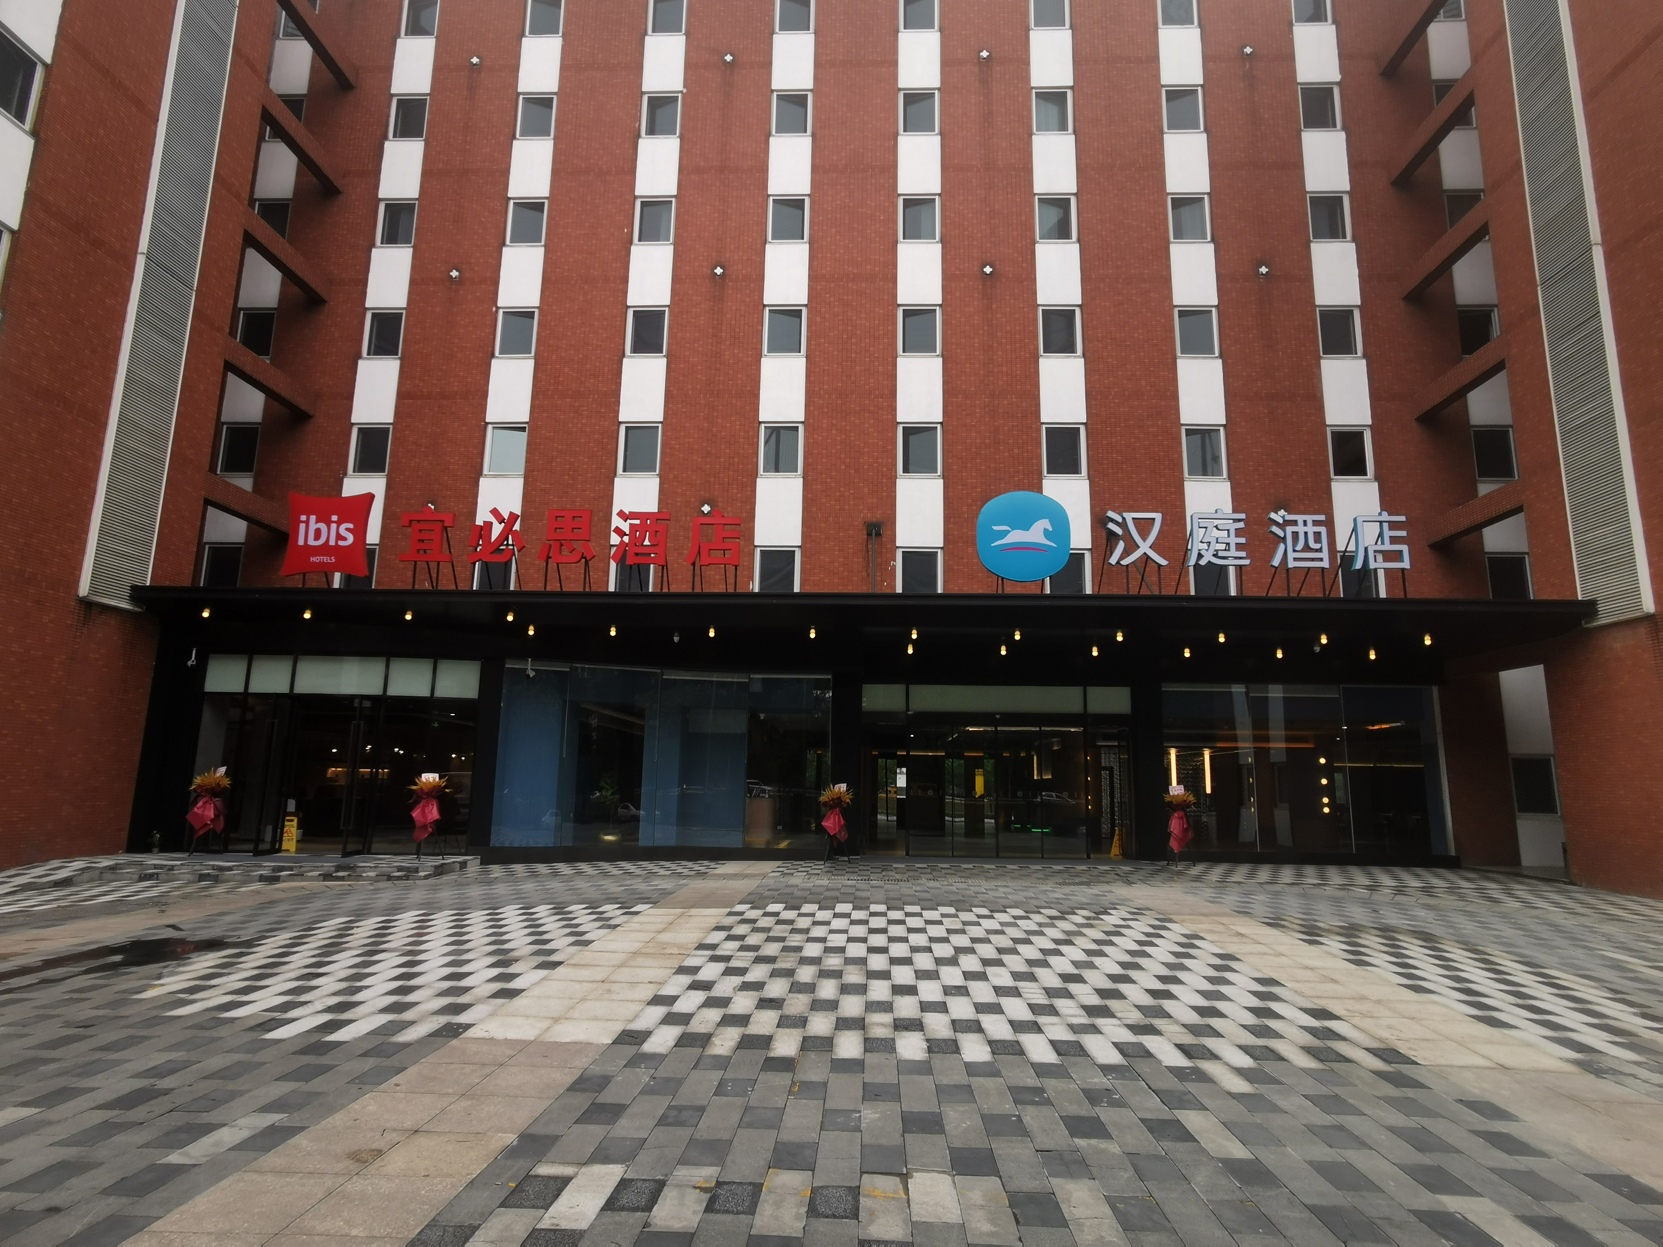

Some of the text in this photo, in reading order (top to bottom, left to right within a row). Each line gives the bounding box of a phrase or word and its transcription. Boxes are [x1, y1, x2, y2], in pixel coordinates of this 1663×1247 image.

[298, 515, 354, 546] ibis
[400, 507, 741, 566] 宜必思酒店
[1105, 508, 1410, 571] 汉庭酒店
